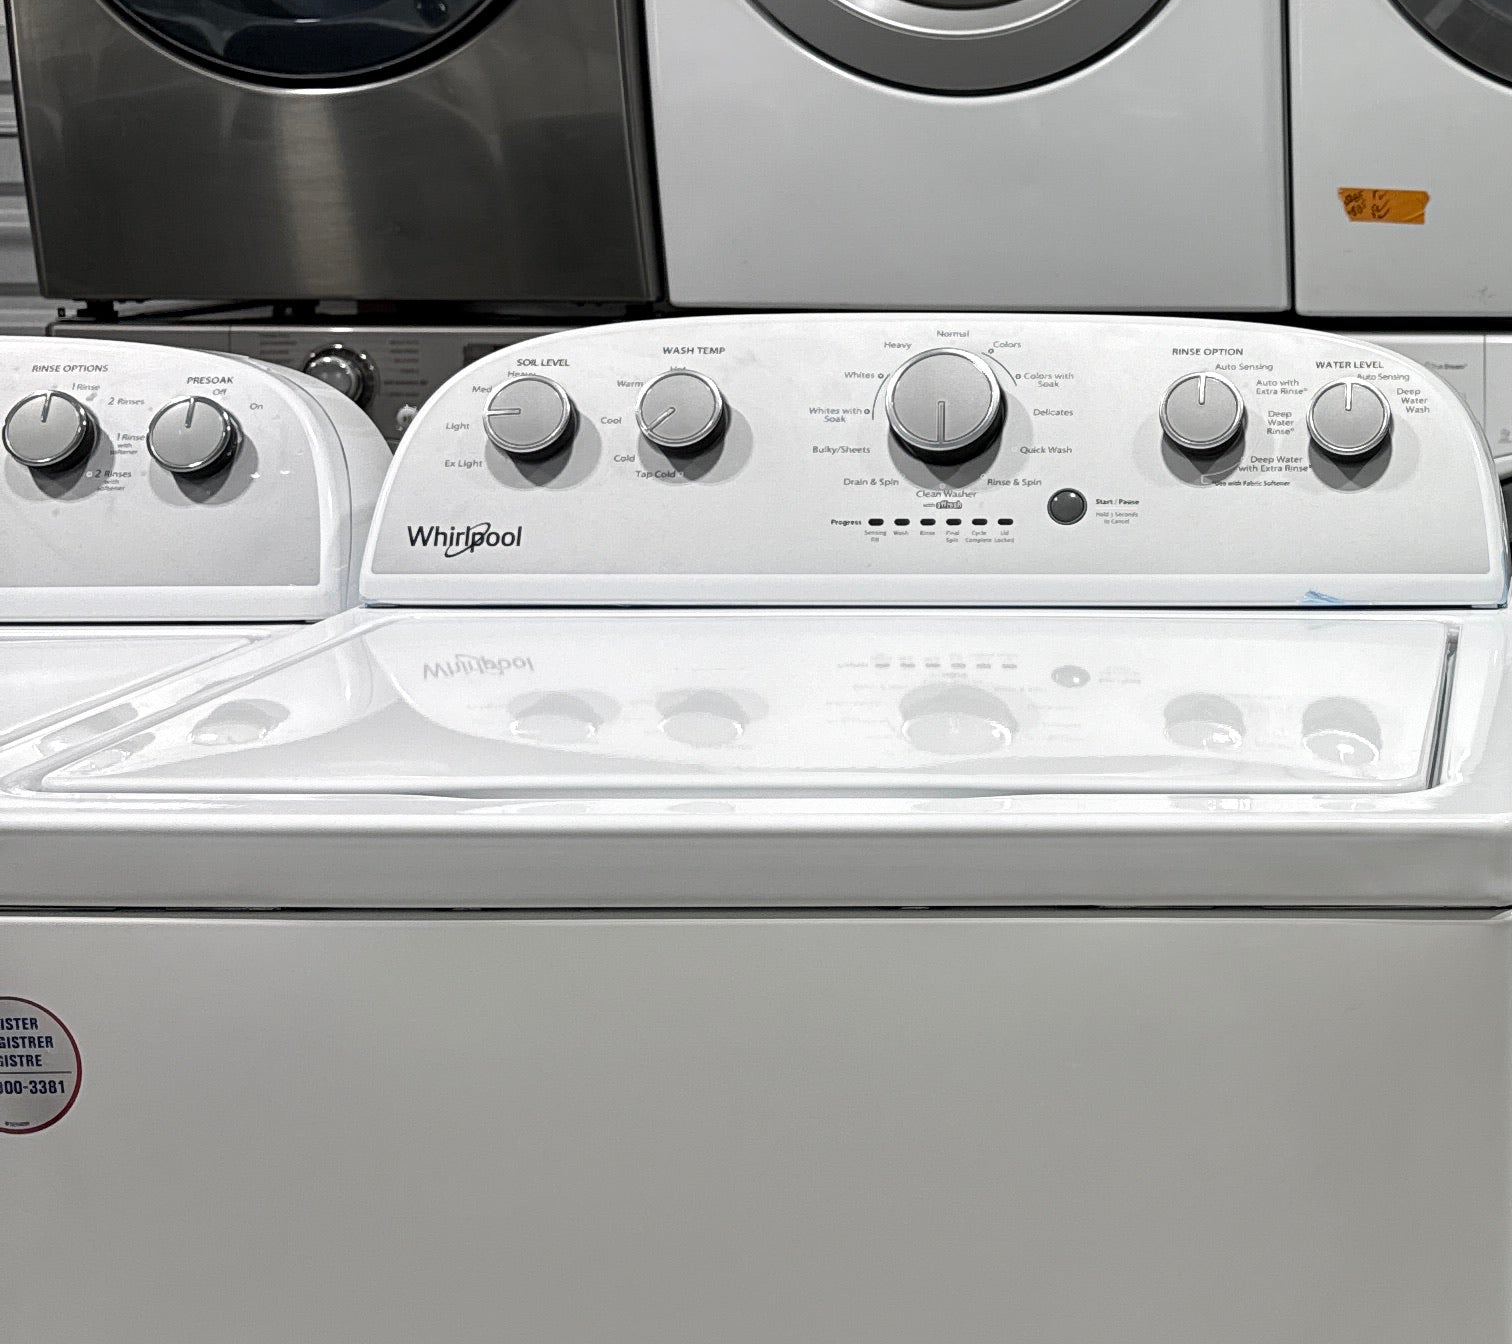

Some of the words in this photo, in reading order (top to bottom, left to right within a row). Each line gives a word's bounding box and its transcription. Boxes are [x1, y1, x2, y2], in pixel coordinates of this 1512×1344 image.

[884, 341, 912, 350] Heavy
[993, 341, 1021, 349] Colors
[1172, 348, 1201, 356] RINSE
[1204, 348, 1243, 356] OPTION
[31, 364, 61, 373] RINSE
[63, 364, 109, 373] OPTIONS
[1239, 364, 1274, 372] Sensing
[1316, 361, 1352, 369] WATER
[1354, 361, 1384, 369] LEVEL
[845, 371, 875, 379] Whites
[1024, 372, 1053, 380] Colors
[1055, 372, 1075, 380] with
[1357, 373, 1376, 381] Auto
[1378, 373, 1410, 381] Sensing
[187, 376, 234, 384] PRESOAK
[77, 383, 100, 391] Rinse
[1397, 388, 1421, 396] Deep
[108, 397, 115, 405] 2
[250, 402, 263, 410] On
[809, 407, 840, 415] Whites
[842, 407, 862, 415] with
[1033, 408, 1074, 417] Delicates
[1268, 410, 1292, 419] Deep
[601, 416, 622, 424] Cool
[824, 415, 846, 423] Soak
[446, 422, 470, 431] Light
[122, 433, 145, 441] Rinse
[812, 446, 871, 455] Bulky/Sheets
[1020, 446, 1046, 455] Quick
[614, 454, 635, 462] Cold
[1250, 455, 1274, 465] Deep
[445, 459, 455, 467] Ex
[458, 459, 482, 469] Light
[1238, 464, 1258, 472] with
[1261, 464, 1283, 472] Extra
[95, 470, 101, 478] 2
[104, 470, 131, 478] Rinses
[636, 471, 652, 479] Tap
[655, 470, 676, 478] Cold
[843, 478, 869, 486] Drain
[870, 478, 878, 486] &
[879, 478, 899, 488] Spin
[987, 478, 1011, 486] Rinse
[1013, 478, 1020, 486] &
[1022, 478, 1042, 488] Spin
[916, 489, 942, 498] Clean
[943, 489, 977, 498] Washer
[831, 519, 862, 527] Progress
[407, 522, 522, 557] Whirlpool
